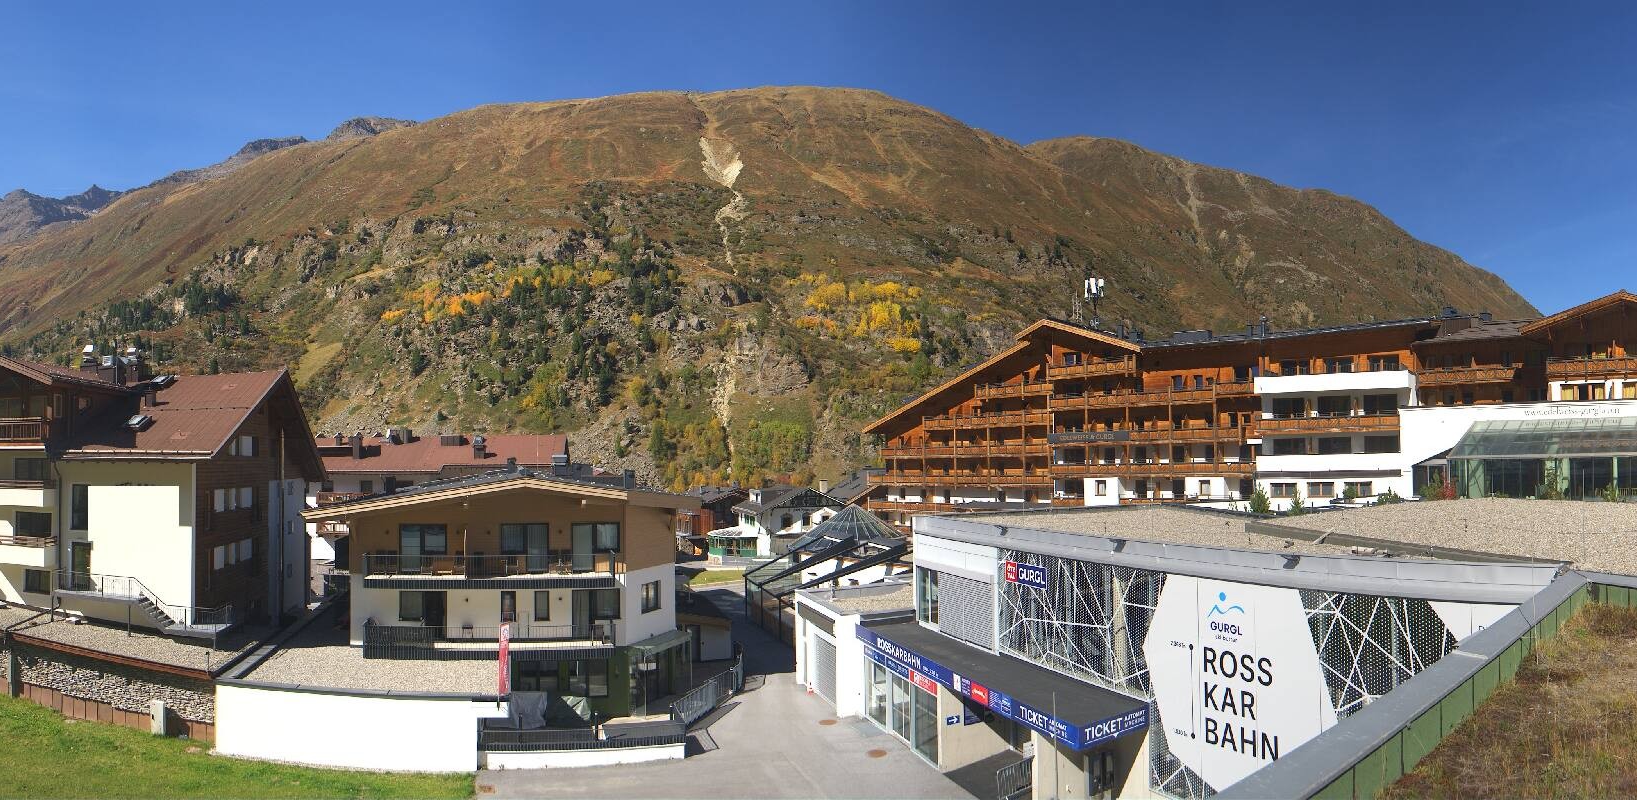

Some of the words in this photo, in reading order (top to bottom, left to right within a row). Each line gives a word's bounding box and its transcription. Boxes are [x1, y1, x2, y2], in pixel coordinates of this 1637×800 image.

[1018, 567, 1046, 585] GURGL
[1210, 620, 1243, 636] GURGL
[876, 637, 921, 670] ROSSKARBAHN
[1203, 646, 1273, 687] ROSS
[1204, 681, 1256, 721] KAR
[1019, 705, 1049, 729] TICKET
[1084, 717, 1123, 741] TICKET
[1205, 717, 1279, 762] BAHN
